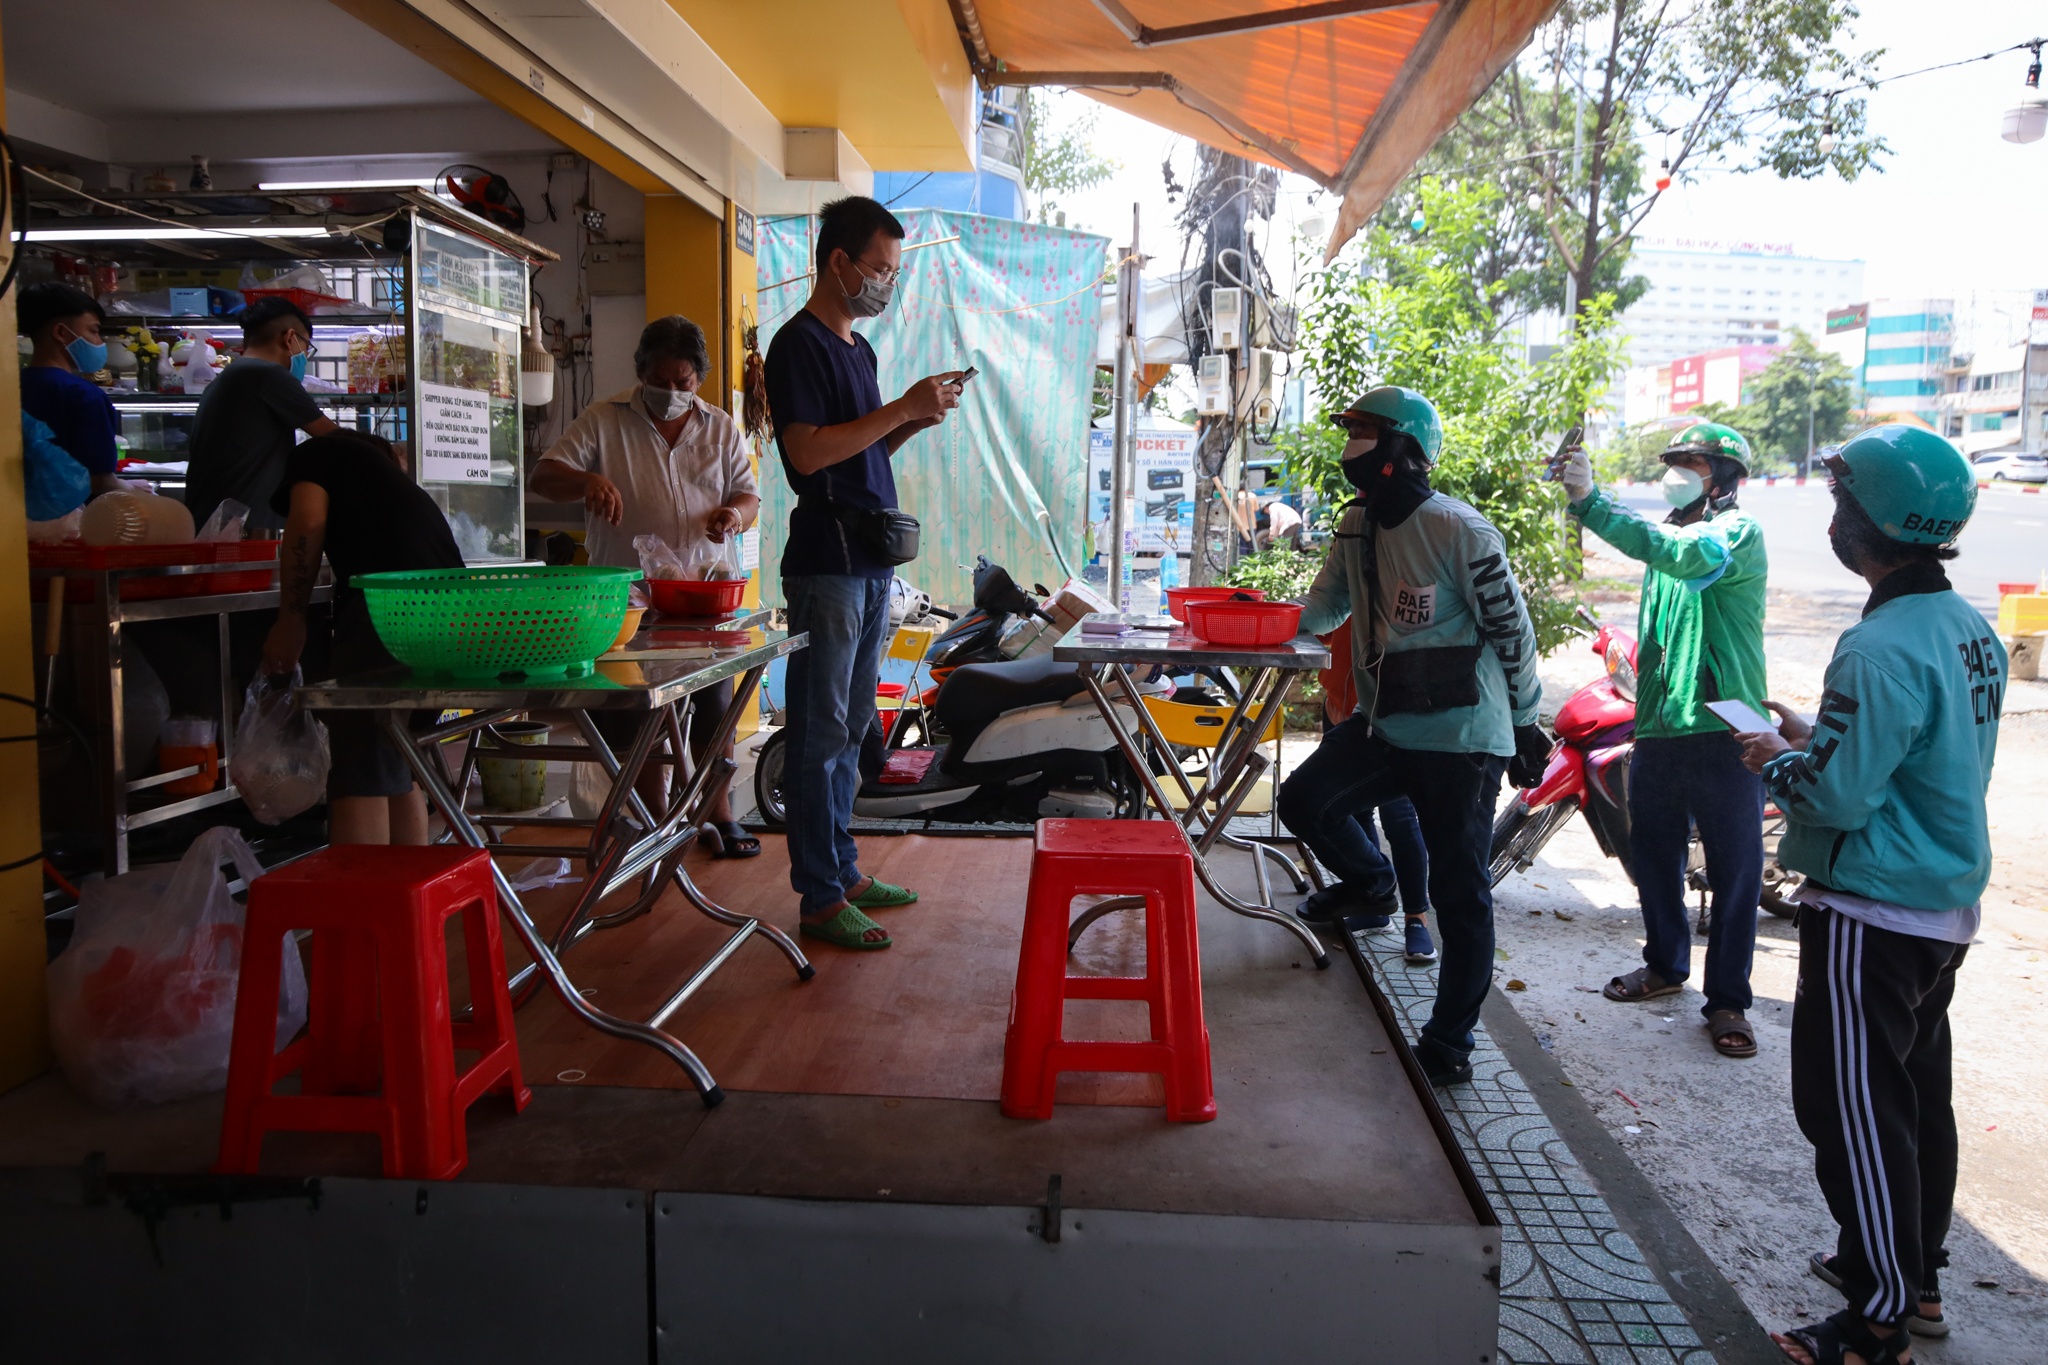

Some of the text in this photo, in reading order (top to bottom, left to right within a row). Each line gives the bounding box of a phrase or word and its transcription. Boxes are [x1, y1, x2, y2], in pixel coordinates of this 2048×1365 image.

[738, 211, 752, 241] 568
[425, 394, 441, 403] SHIPPER
[451, 410, 462, 419] CÁCH
[1136, 439, 1186, 451] OCKET
[1142, 458, 1151, 466] SỐ
[1174, 458, 1191, 466] QUỐC
[1398, 590, 1430, 610] BAE
[1394, 606, 1430, 625] MIN
[1958, 637, 1998, 683] BAE
